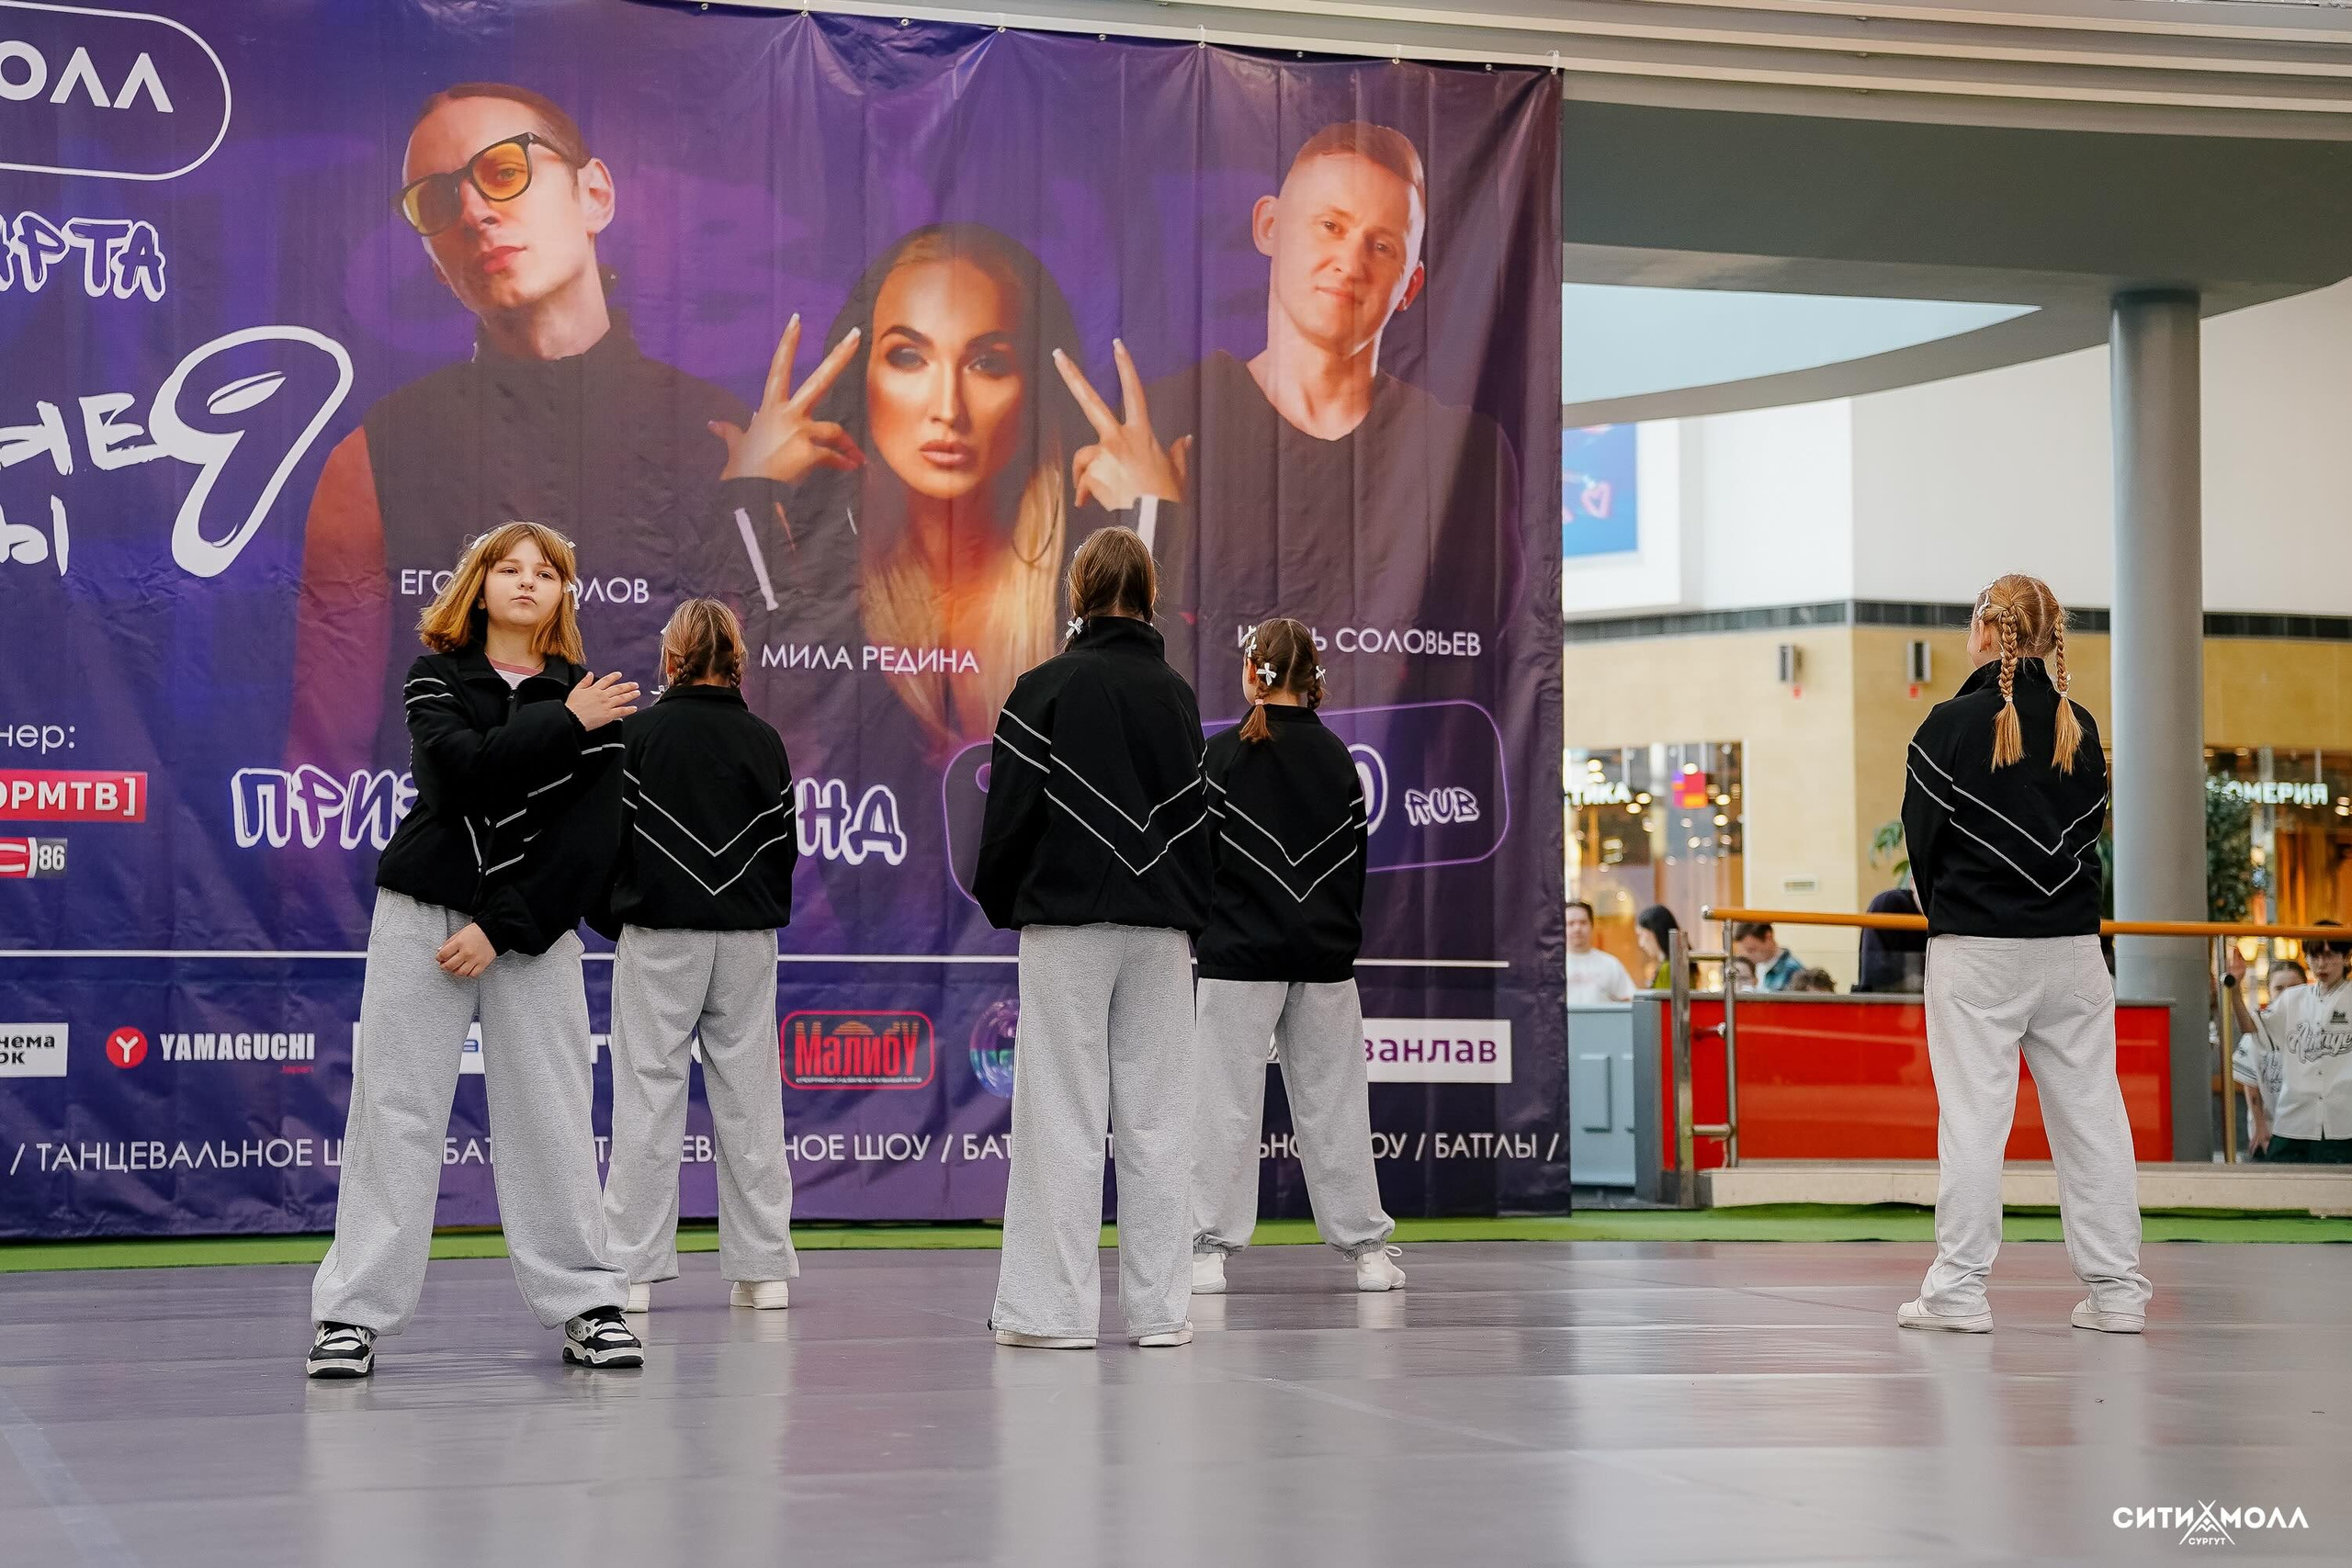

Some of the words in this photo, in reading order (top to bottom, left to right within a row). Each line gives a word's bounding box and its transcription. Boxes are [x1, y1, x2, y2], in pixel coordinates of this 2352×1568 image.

[401, 569, 455, 595] ЕГО
[1335, 626, 1482, 657] СОЛОВЬЕВ
[762, 643, 854, 671] МИЛА
[862, 645, 979, 675] РЕДИНА
[796, 777, 907, 866] НД
[1405, 787, 1481, 827] RUB
[39, 844, 66, 872] 86
[159, 1032, 315, 1061] YAMAGUCHI
[36, 1138, 313, 1173] ТАНЦЕВАЛЬНОЕ
[854, 1133, 932, 1161] ШОУ
[1371, 1132, 1408, 1159] ОУ
[1435, 1133, 1537, 1159] БАТТЛЫ
